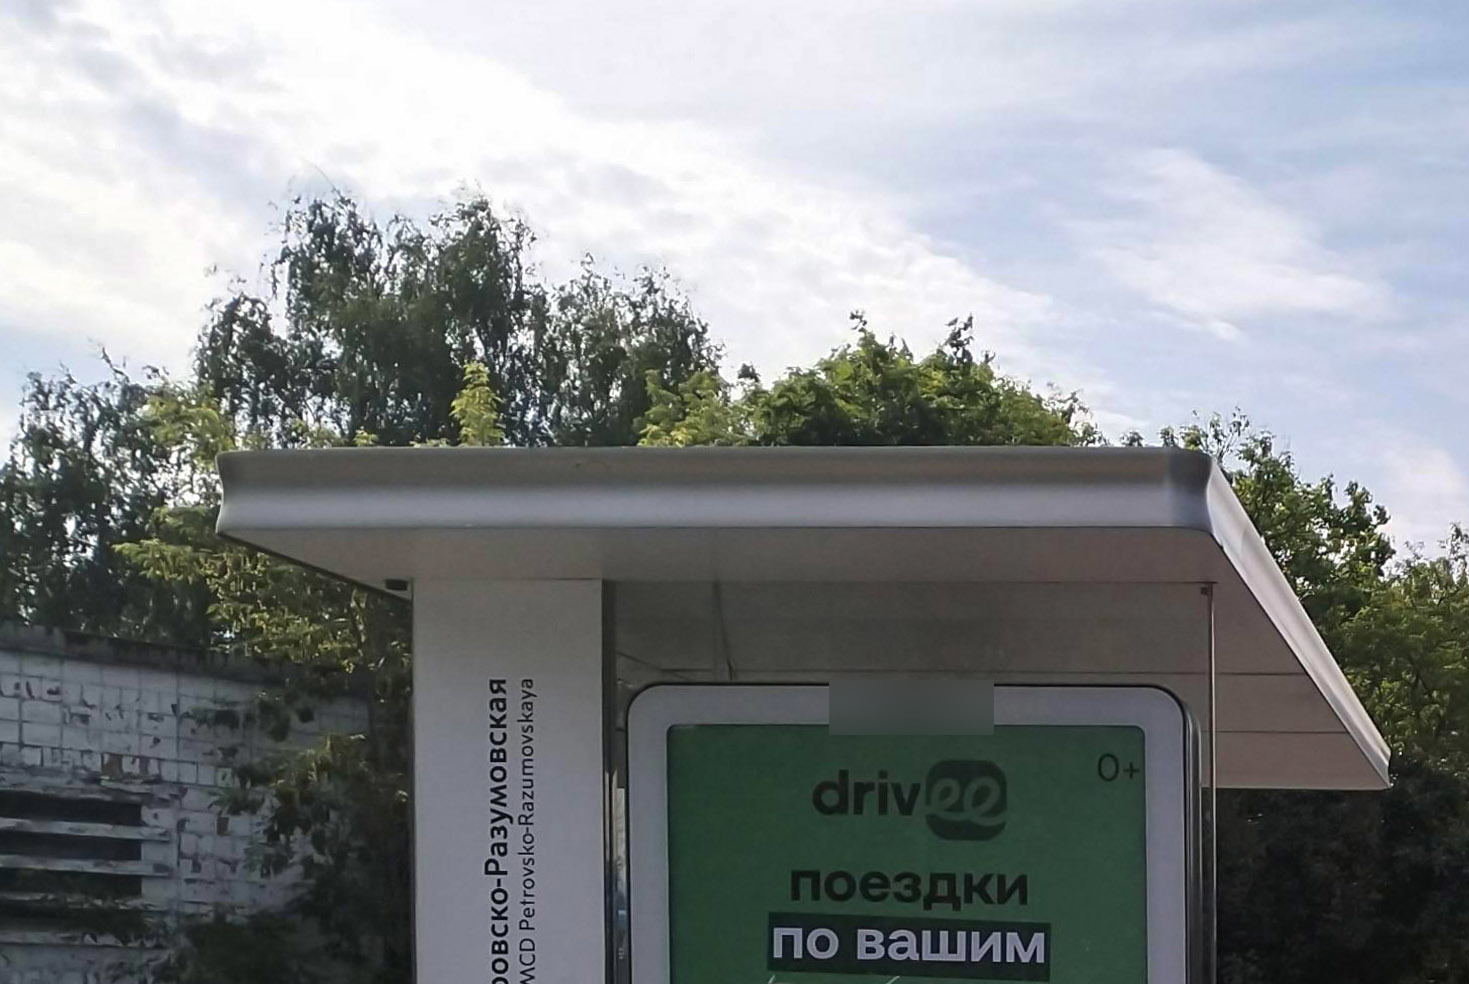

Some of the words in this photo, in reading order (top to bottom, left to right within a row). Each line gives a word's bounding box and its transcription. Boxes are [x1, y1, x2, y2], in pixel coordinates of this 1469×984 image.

[1097, 753, 1140, 782] 0+
[517, 678, 537, 932] Petrovsko-Razumovskaya
[812, 764, 1007, 834] drivee
[790, 869, 1028, 911] поездки
[773, 926, 839, 960] по
[857, 928, 1045, 964] вашим
